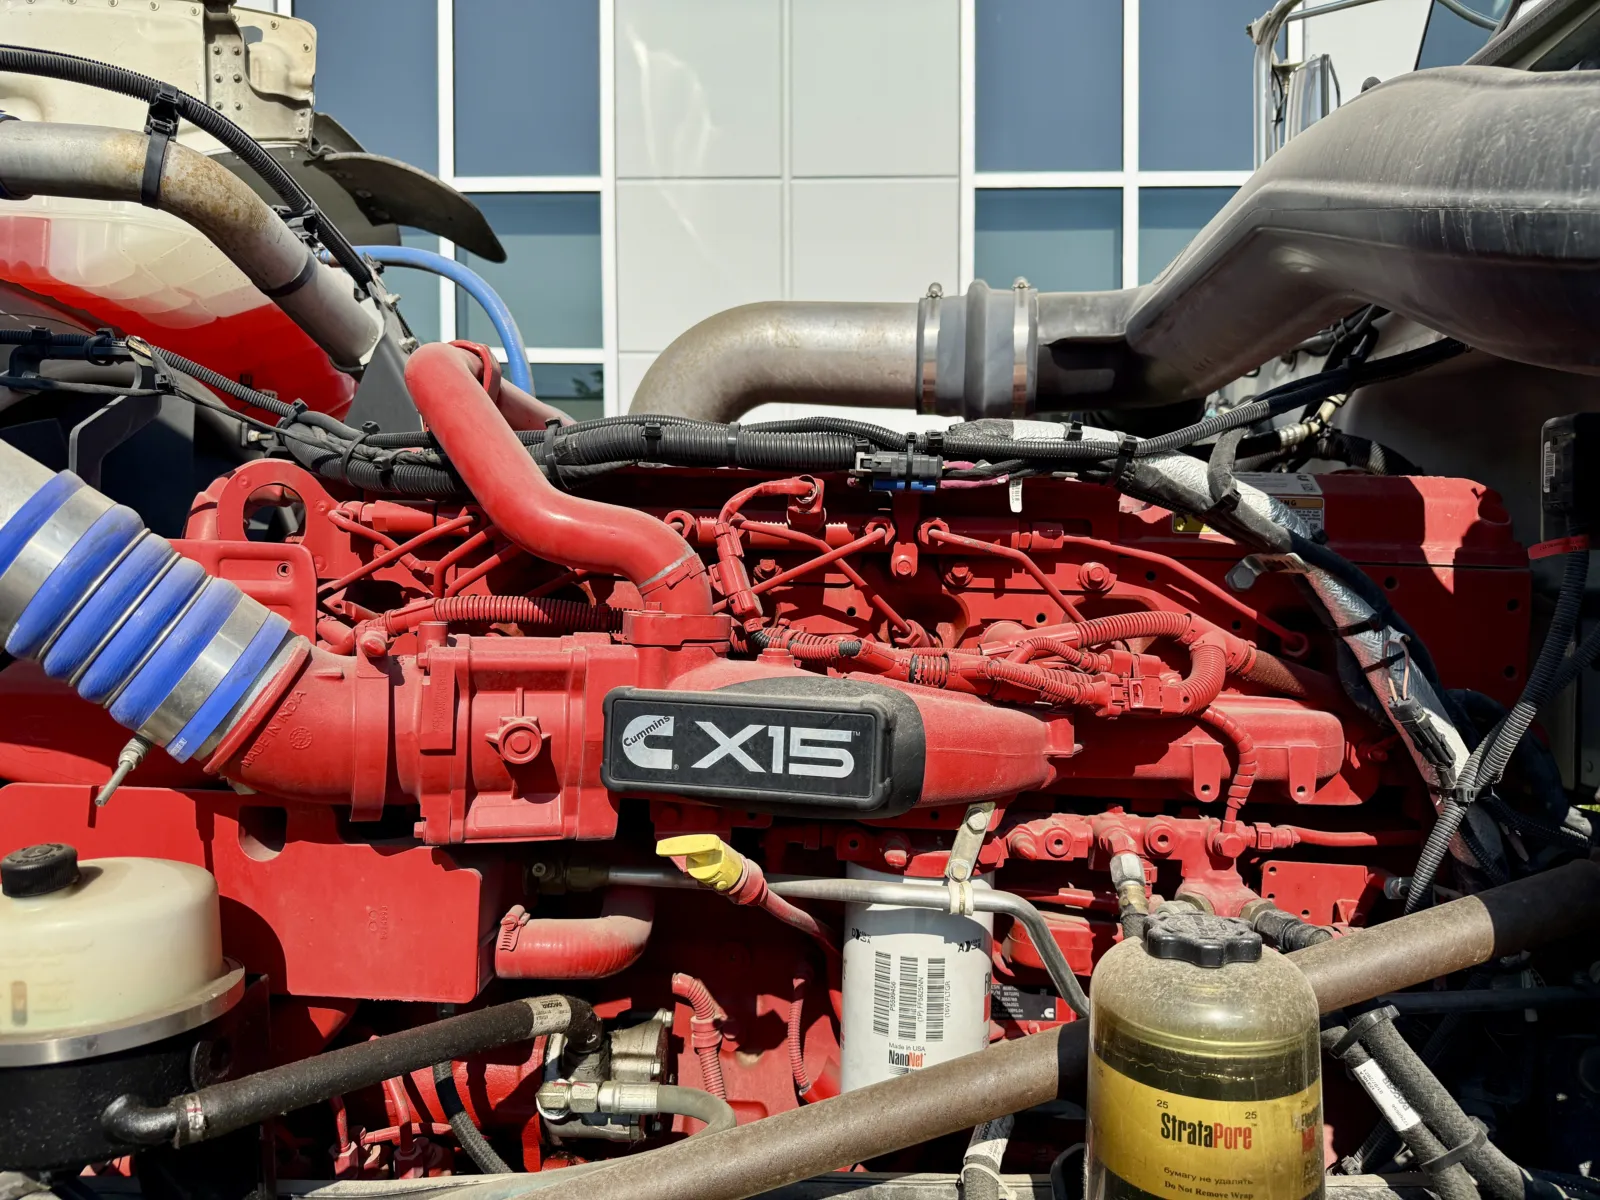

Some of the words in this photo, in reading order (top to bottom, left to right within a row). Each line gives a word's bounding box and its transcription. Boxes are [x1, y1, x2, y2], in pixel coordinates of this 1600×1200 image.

[241, 737, 272, 768] MADE
[266, 725, 281, 738] IN
[277, 690, 306, 724] INDIA
[622, 714, 671, 748] Cummins
[690, 720, 855, 779] X15
[888, 1049, 924, 1067] NanoNet
[1156, 1099, 1169, 1109] 25
[1244, 1111, 1257, 1120] 25
[1160, 1112, 1252, 1150] StrataPore
[1163, 1166, 1197, 1182] бумагу
[1164, 1180, 1176, 1190] Do
[1178, 1183, 1193, 1194] Not
[1195, 1188, 1229, 1199] Remove
[1230, 1191, 1254, 1200] Wrap
